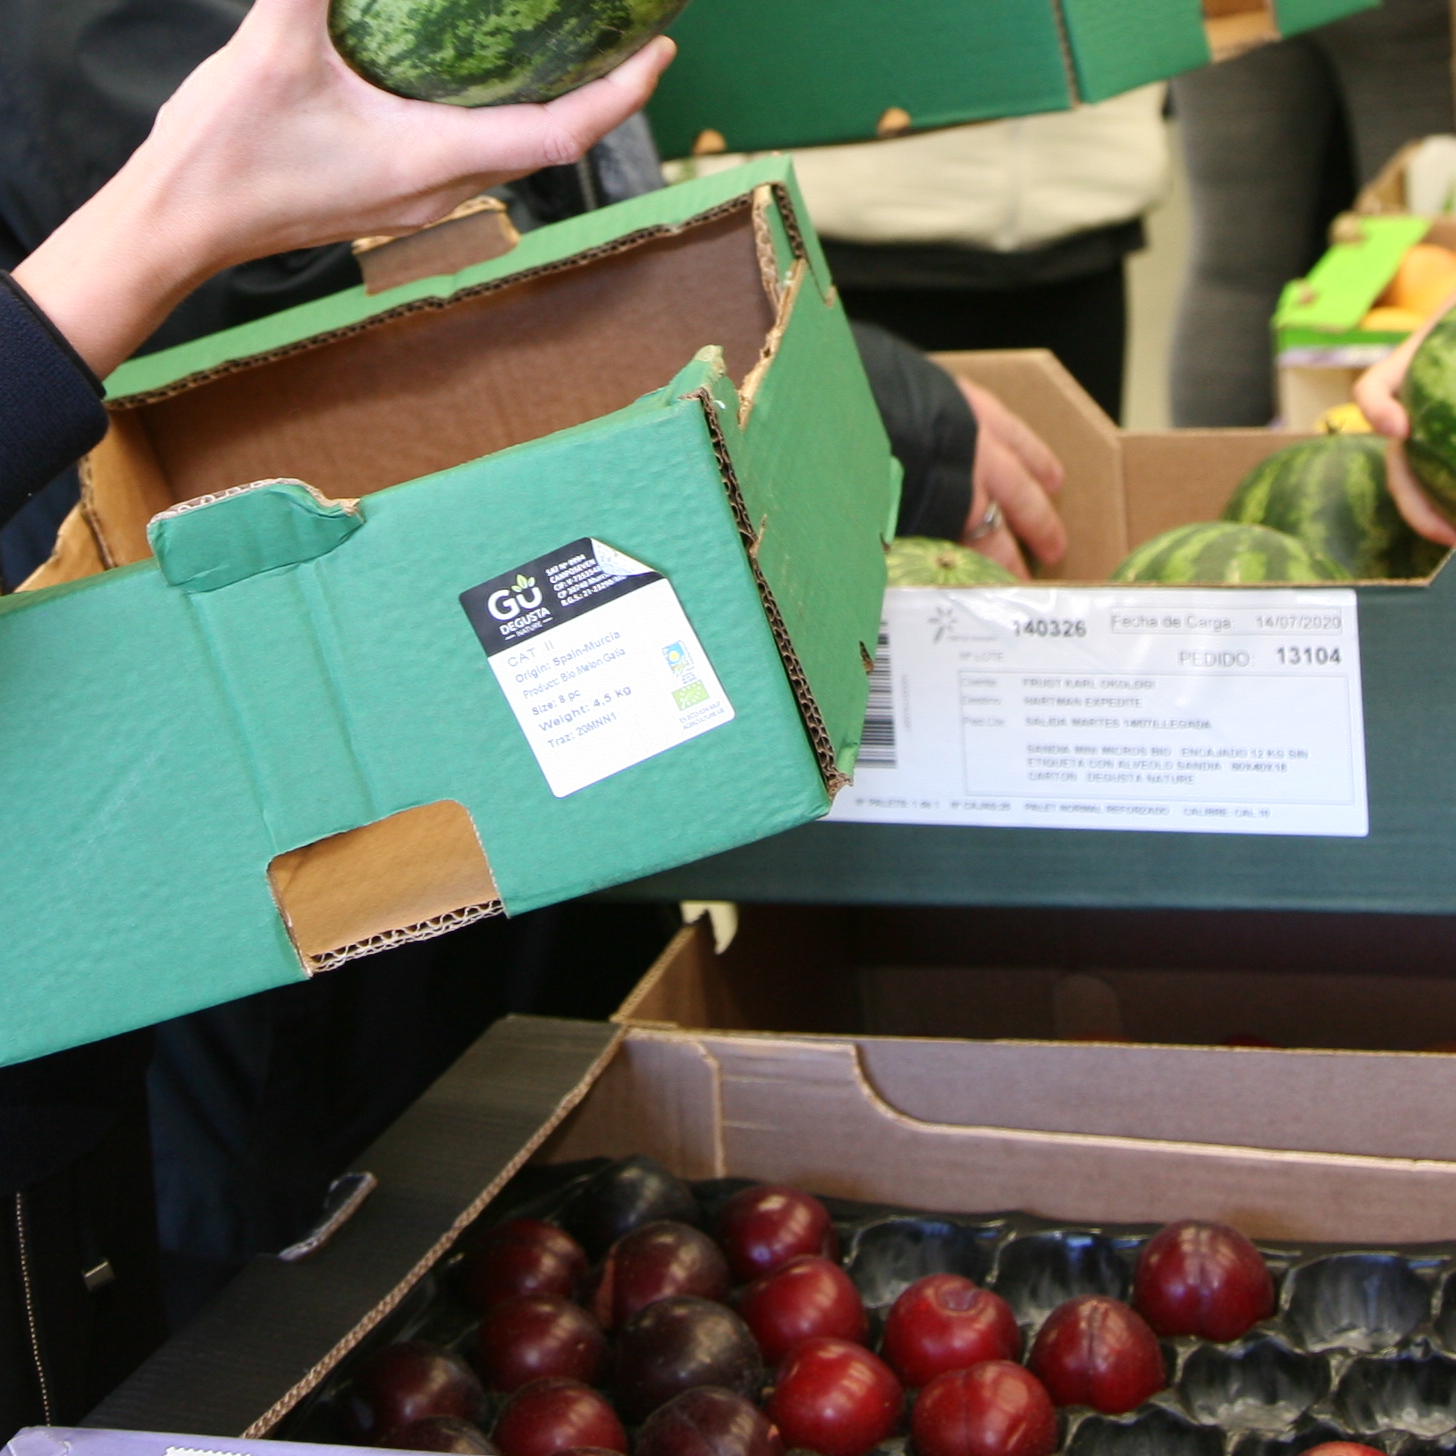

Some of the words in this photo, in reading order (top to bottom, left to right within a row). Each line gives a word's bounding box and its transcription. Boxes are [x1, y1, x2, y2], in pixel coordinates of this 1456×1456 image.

[499, 606, 550, 635] DEGUSTA
[516, 621, 543, 637] NATURE
[1012, 620, 1087, 637] 140326
[1112, 615, 1157, 629] Fecha
[1163, 616, 1182, 628] de
[507, 647, 538, 668] CAT
[515, 661, 551, 685] Origin:
[553, 630, 620, 666] Spain-Murcia
[1276, 647, 1342, 665] 13104
[523, 677, 559, 699] Product:
[561, 670, 575, 682] Bio
[577, 657, 603, 674] Melon
[532, 699, 557, 716] Size:
[558, 695, 565, 703] 8
[568, 689, 581, 701] pc
[539, 703, 591, 734] Weight:
[614, 684, 631, 699] kg
[548, 731, 574, 749] Traz:
